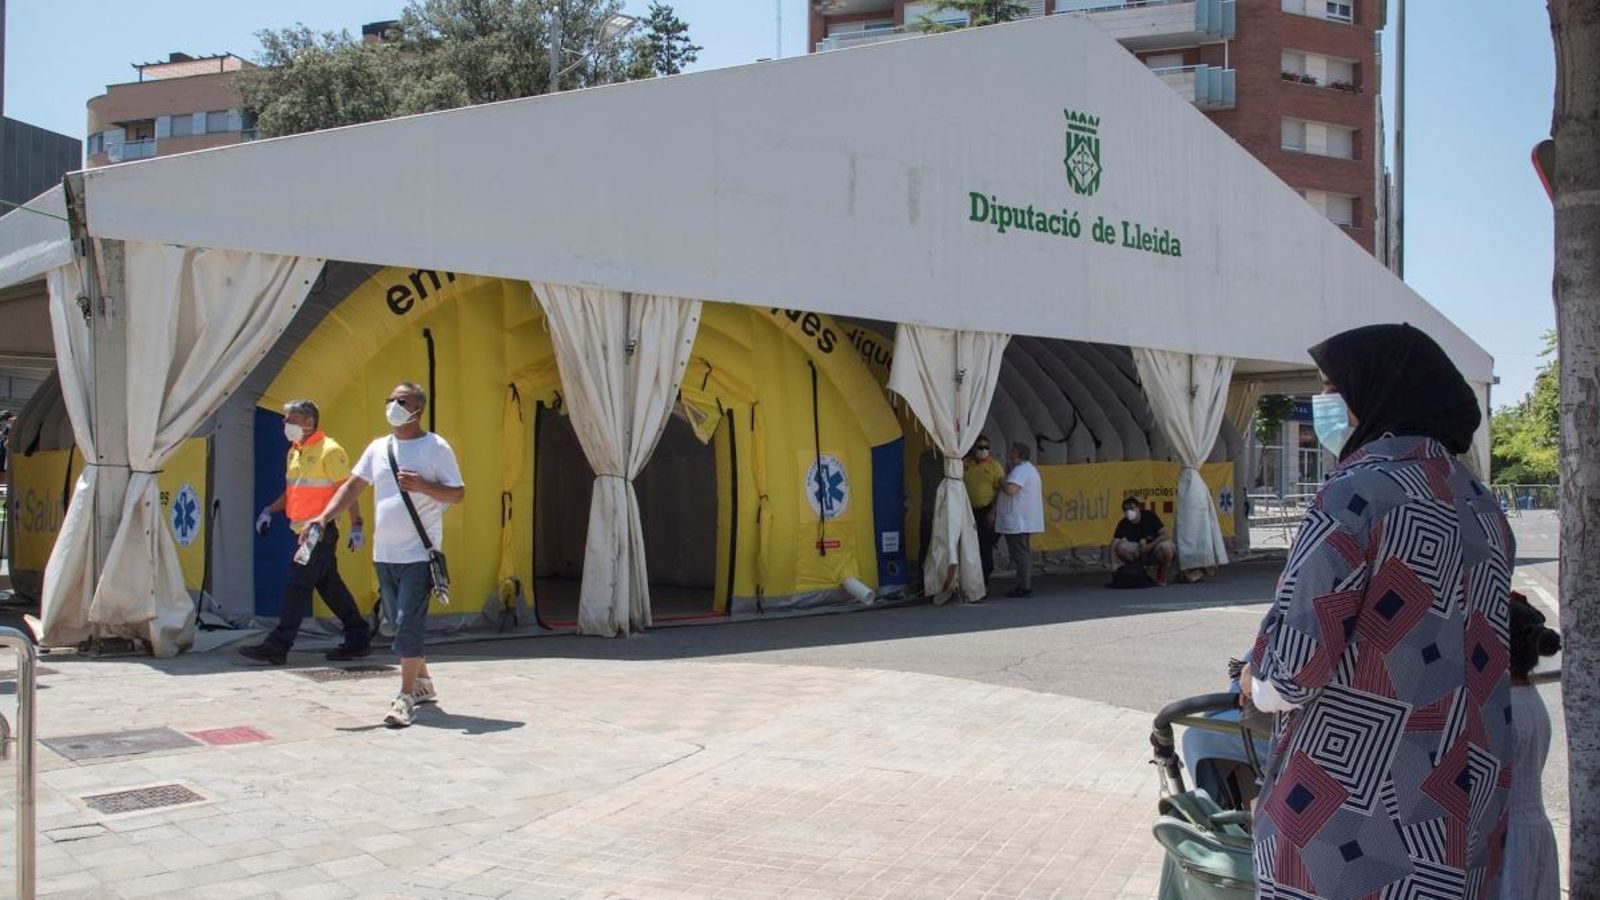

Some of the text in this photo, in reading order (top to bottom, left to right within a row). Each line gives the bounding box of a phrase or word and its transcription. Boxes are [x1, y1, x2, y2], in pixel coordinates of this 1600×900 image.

[969, 191, 1182, 258] Diputació de Lleida
